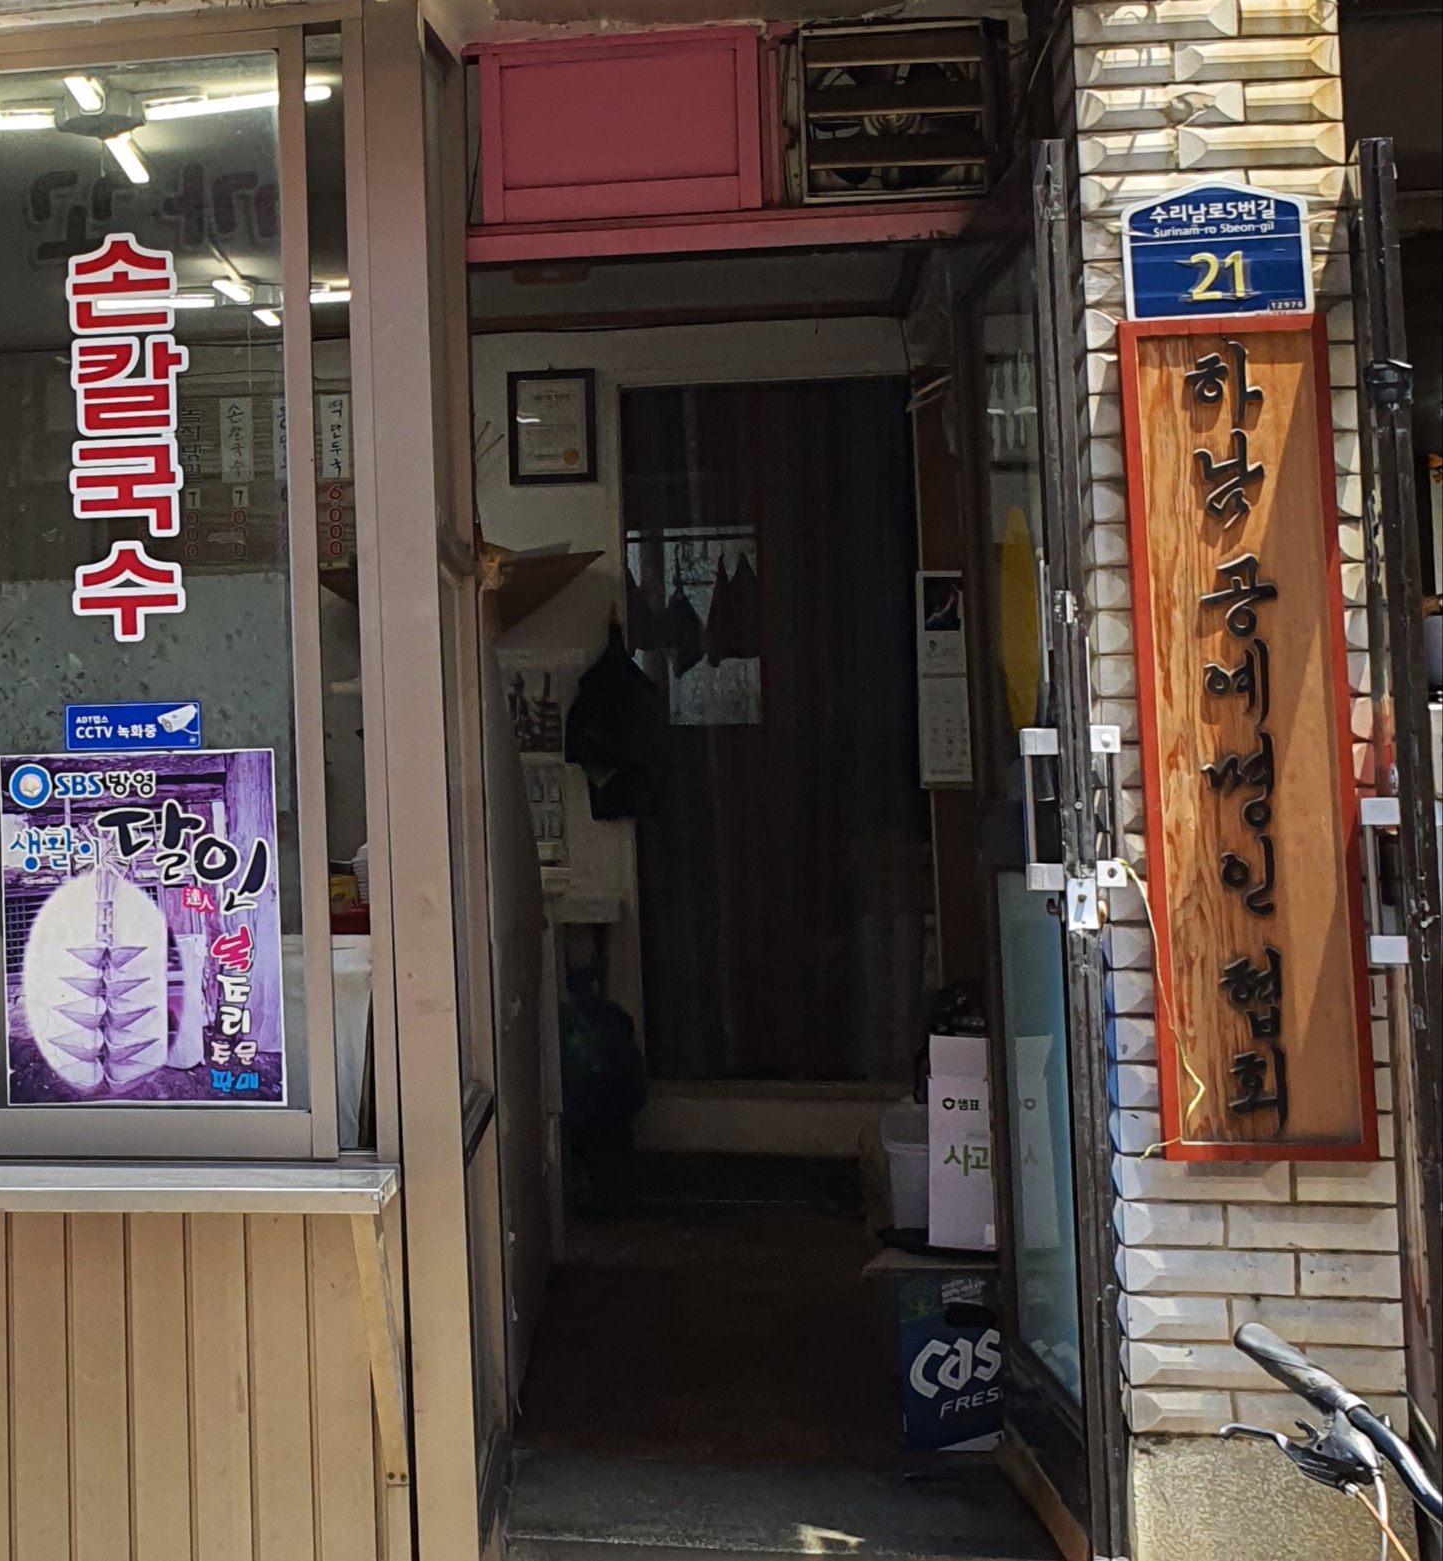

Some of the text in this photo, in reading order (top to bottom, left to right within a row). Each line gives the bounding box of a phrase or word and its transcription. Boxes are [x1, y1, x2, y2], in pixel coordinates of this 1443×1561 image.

[1149, 199, 1276, 224] 수리남로5번길
[1153, 221, 1275, 238] Surinam-ro 5beon-gil
[1189, 250, 1247, 301] 21
[1270, 300, 1304, 310] 12976
[66, 233, 188, 641] 손칼국수
[226, 404, 245, 478] 손칼국수
[1184, 340, 1265, 529] 하남
[75, 715, 109, 724] ADT캡스
[75, 723, 158, 739] CCTV 녹화중
[56, 771, 156, 798] SBS 방영
[9, 799, 269, 915] 생활의 달인
[1218, 945, 1289, 1136] 협회
[211, 1068, 260, 1093] 판매
